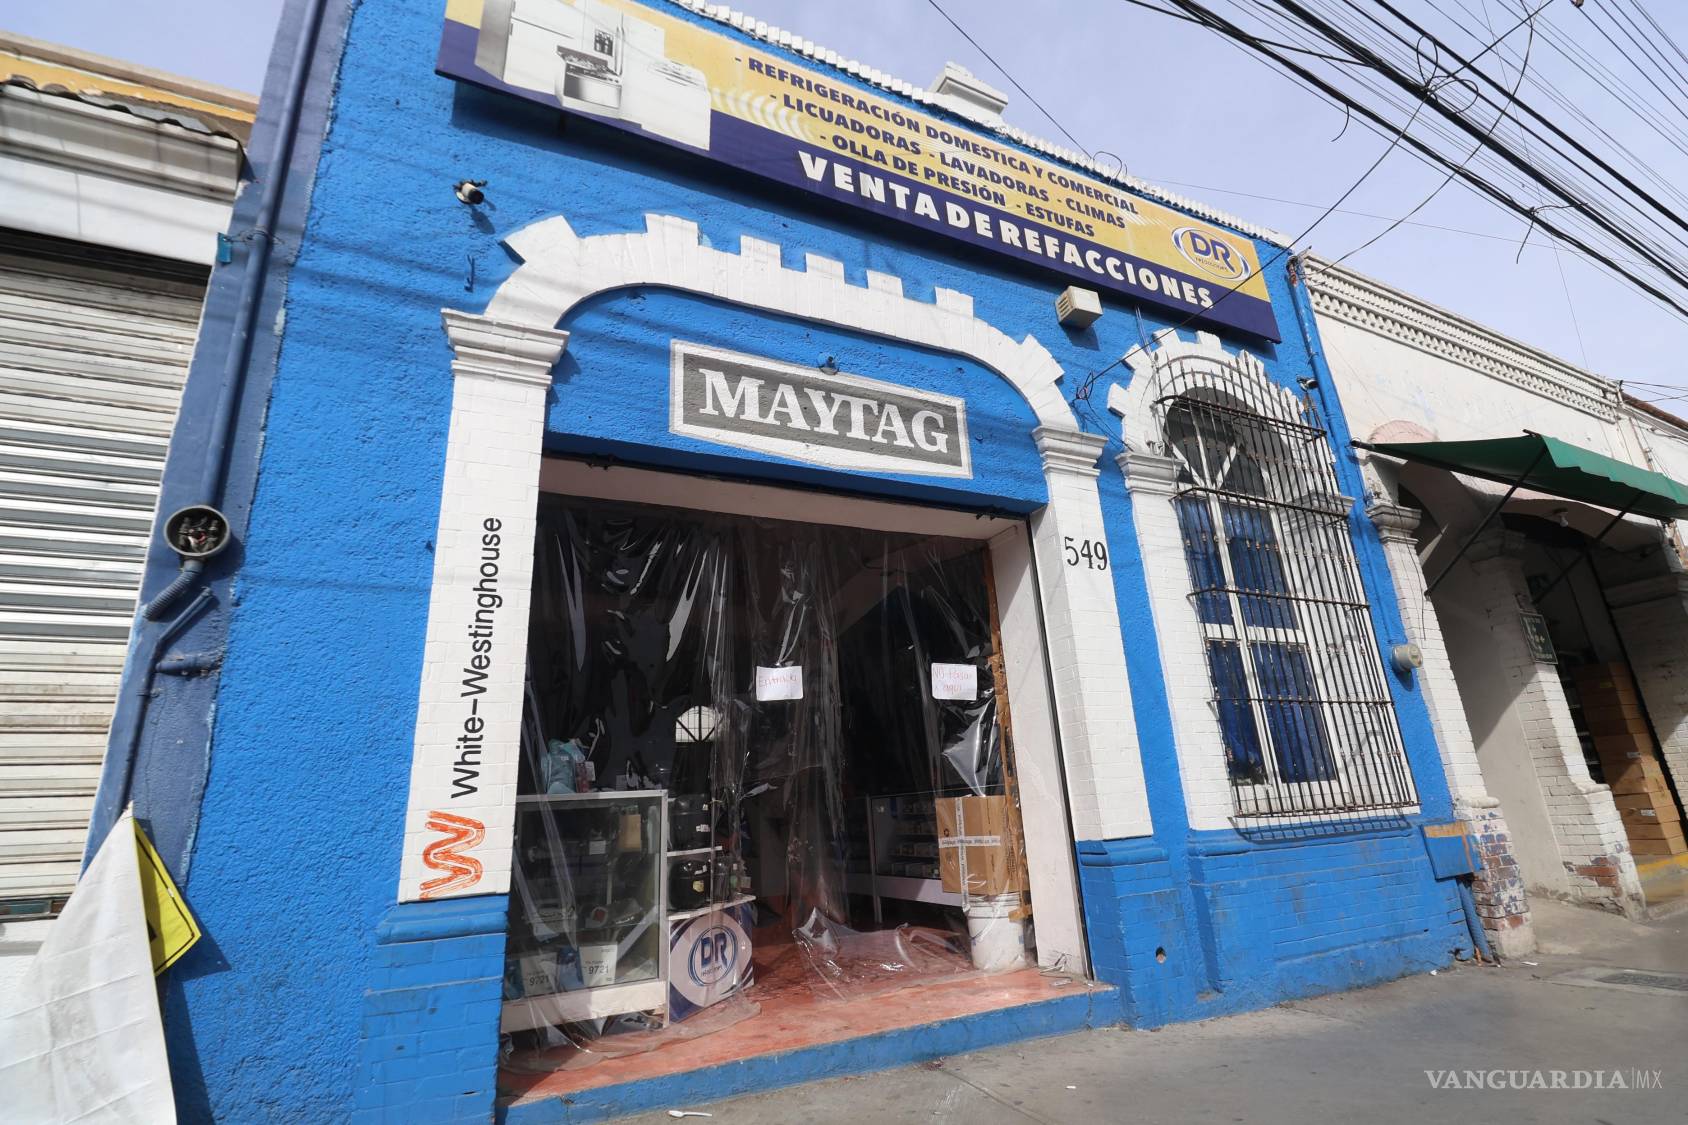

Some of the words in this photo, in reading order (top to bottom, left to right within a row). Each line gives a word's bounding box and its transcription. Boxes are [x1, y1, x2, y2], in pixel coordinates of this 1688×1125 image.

[748, 57, 921, 133] REFRIGERACIÓN
[925, 124, 1031, 175] DOMESTICA
[1031, 165, 1044, 179] Y
[1047, 172, 1139, 215] COMERCIAL
[783, 93, 921, 155] LICUADORAS
[939, 151, 1050, 201] LAVADORAS
[1065, 197, 1126, 229] CLIMAS
[798, 150, 940, 222] VENTA
[945, 201, 994, 239] DE
[999, 219, 1214, 309] REFACCIONES
[831, 134, 888, 166] OLLA
[892, 155, 919, 176] DE
[923, 166, 1006, 206] PRESIÓN
[1025, 202, 1095, 237] ESTUFAS
[1189, 231, 1236, 274] DR
[698, 368, 948, 454] MAYTAG
[1064, 536, 1108, 571] 549
[700, 932, 728, 969] DR
